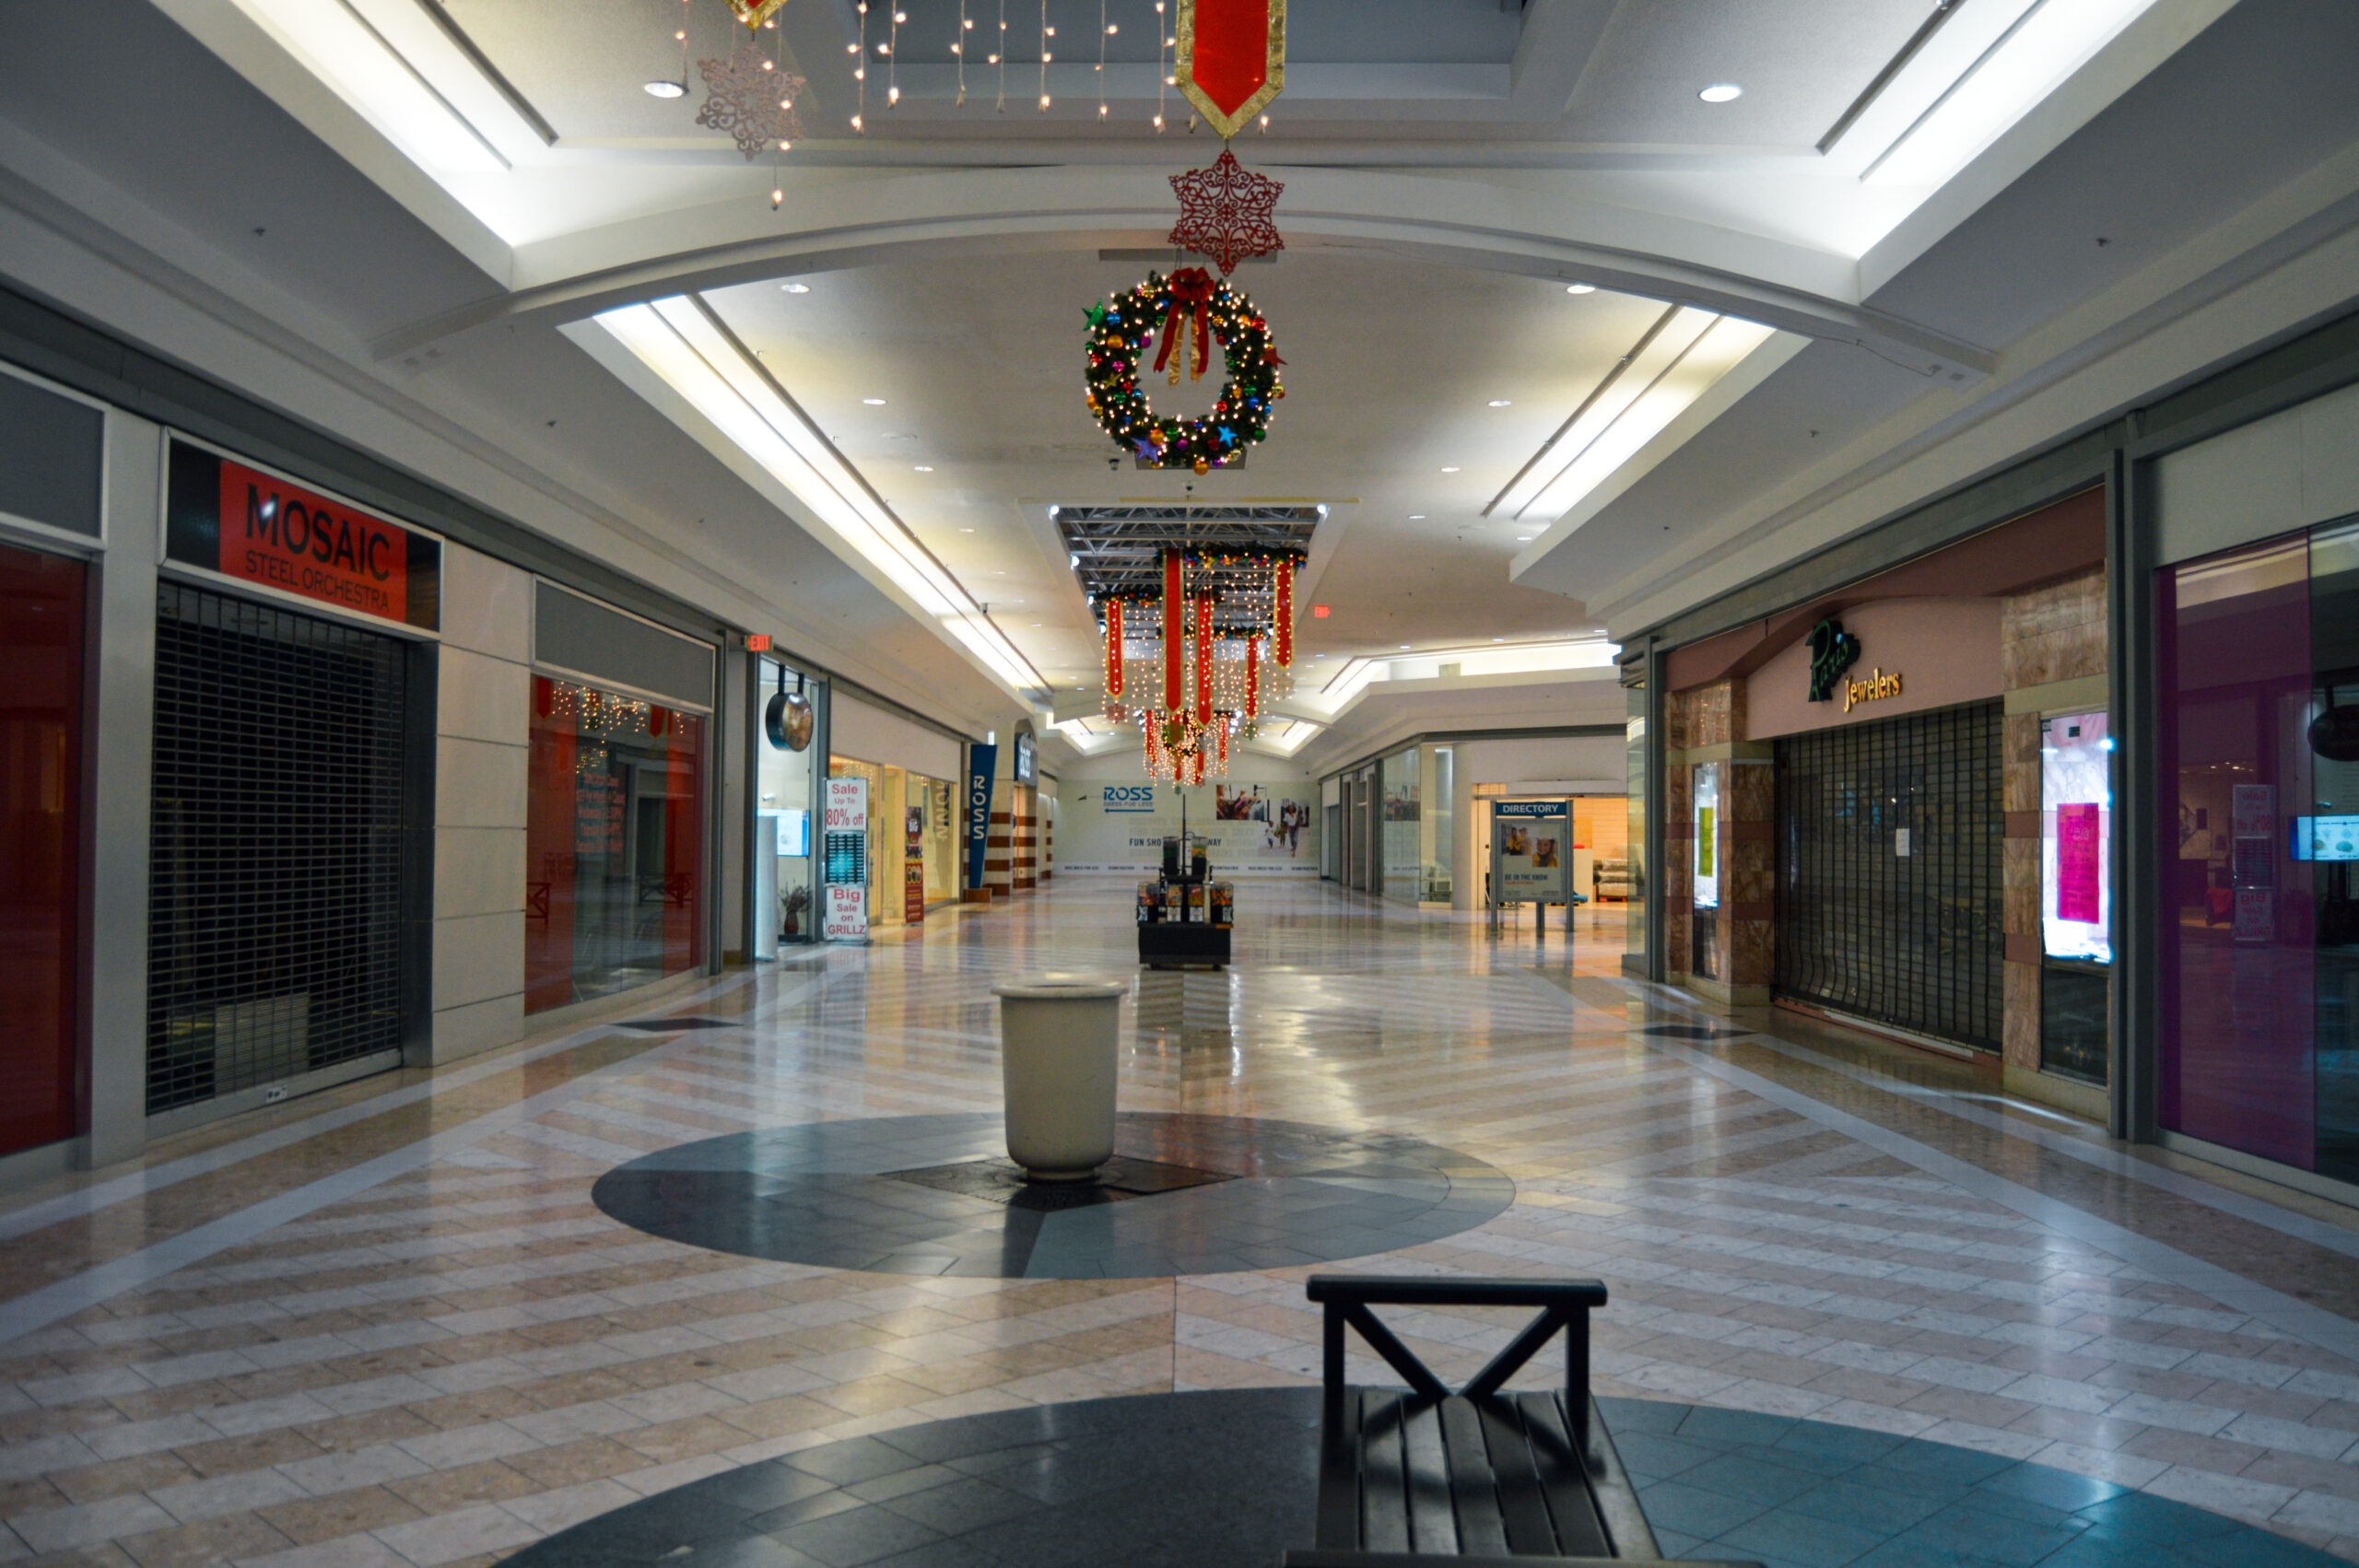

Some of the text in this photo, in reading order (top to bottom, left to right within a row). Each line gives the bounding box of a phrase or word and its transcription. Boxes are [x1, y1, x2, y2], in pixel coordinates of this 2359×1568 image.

[247, 485, 390, 581] MOSAIC
[246, 550, 389, 611] STEEL ORCHESTRA
[750, 634, 770, 651] EXIT
[831, 783, 858, 795] Sale
[1104, 787, 1153, 801] ROSS
[834, 797, 845, 806] Up
[973, 775, 986, 841] ROSS
[1502, 804, 1559, 813] DIRECTORY
[826, 808, 864, 826] 80% off
[1129, 838, 1144, 848] FUN
[833, 888, 861, 903] Big
[836, 904, 858, 912] Sale
[840, 914, 854, 922] on
[827, 924, 866, 934] GRILLZ
